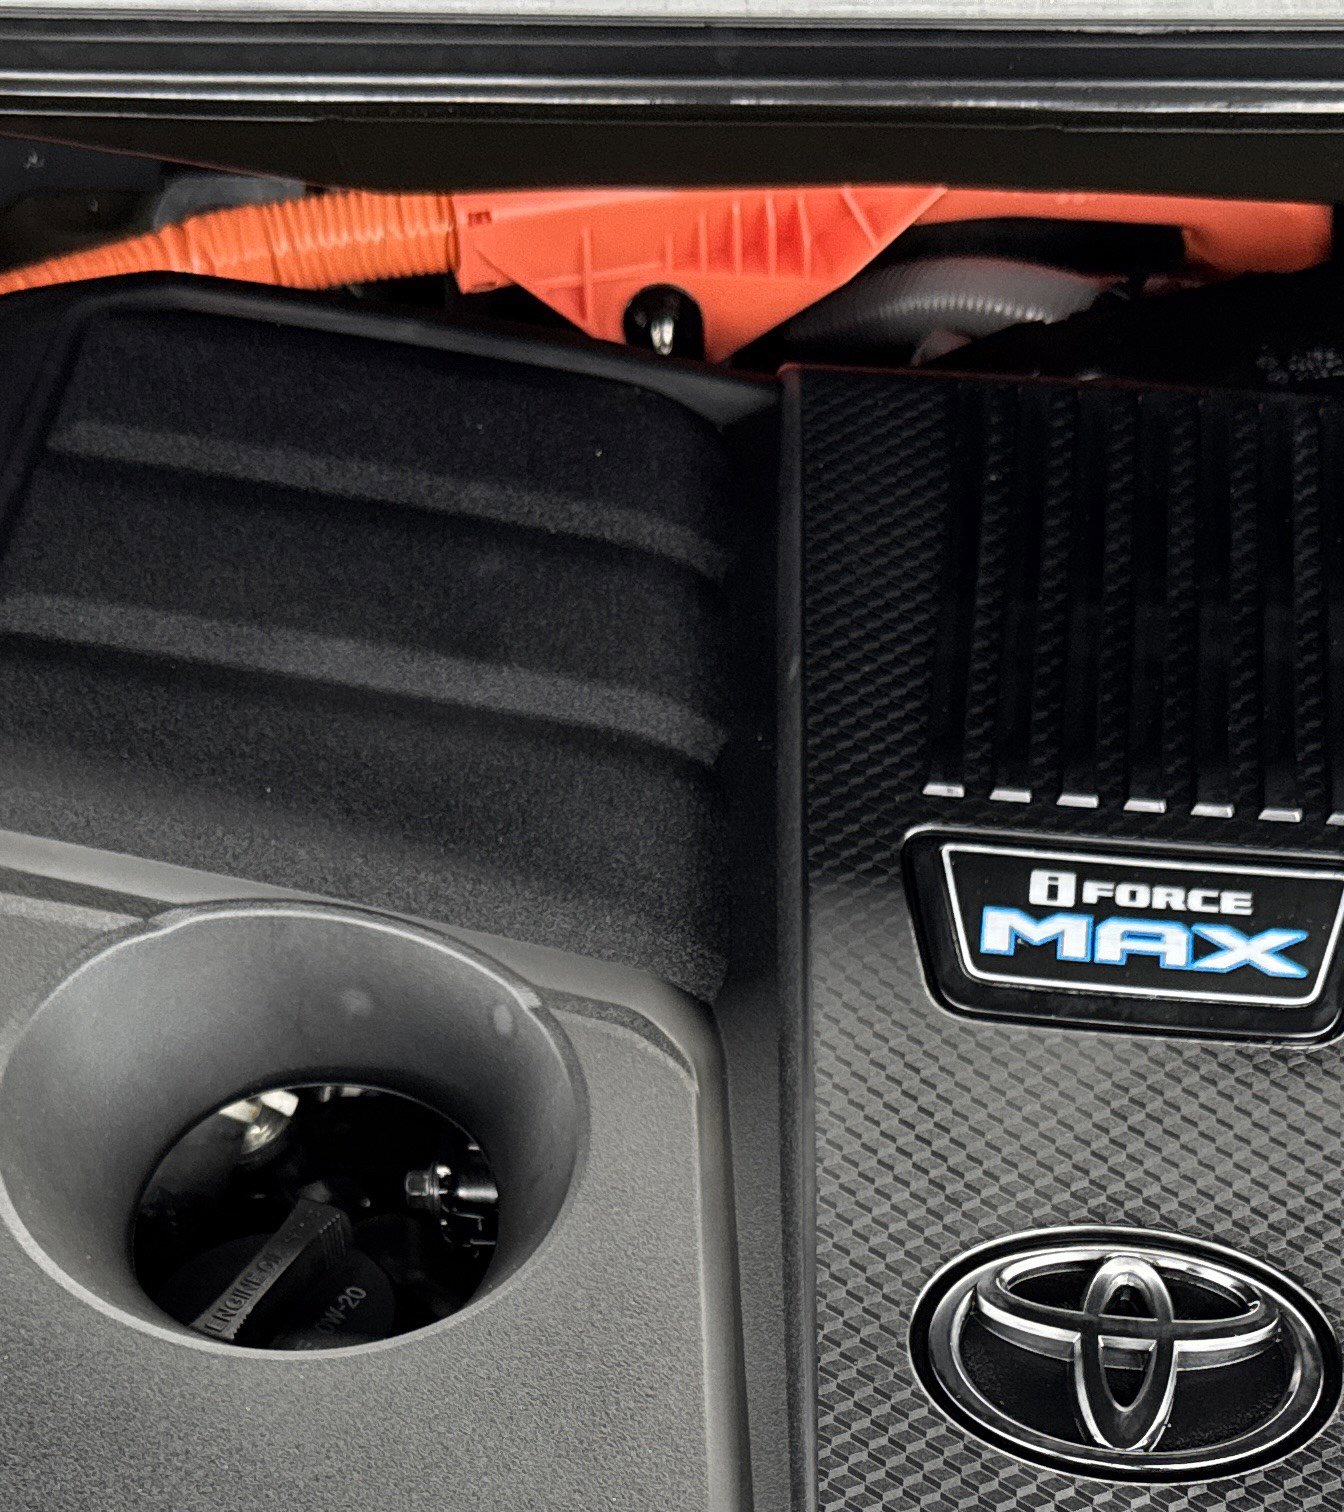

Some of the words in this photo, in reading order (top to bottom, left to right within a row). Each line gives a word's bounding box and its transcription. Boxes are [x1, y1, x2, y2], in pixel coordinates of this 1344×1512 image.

[1082, 881, 1254, 917] FORCE
[979, 905, 1310, 979] MAX
[204, 1269, 262, 1334] ENGINE
